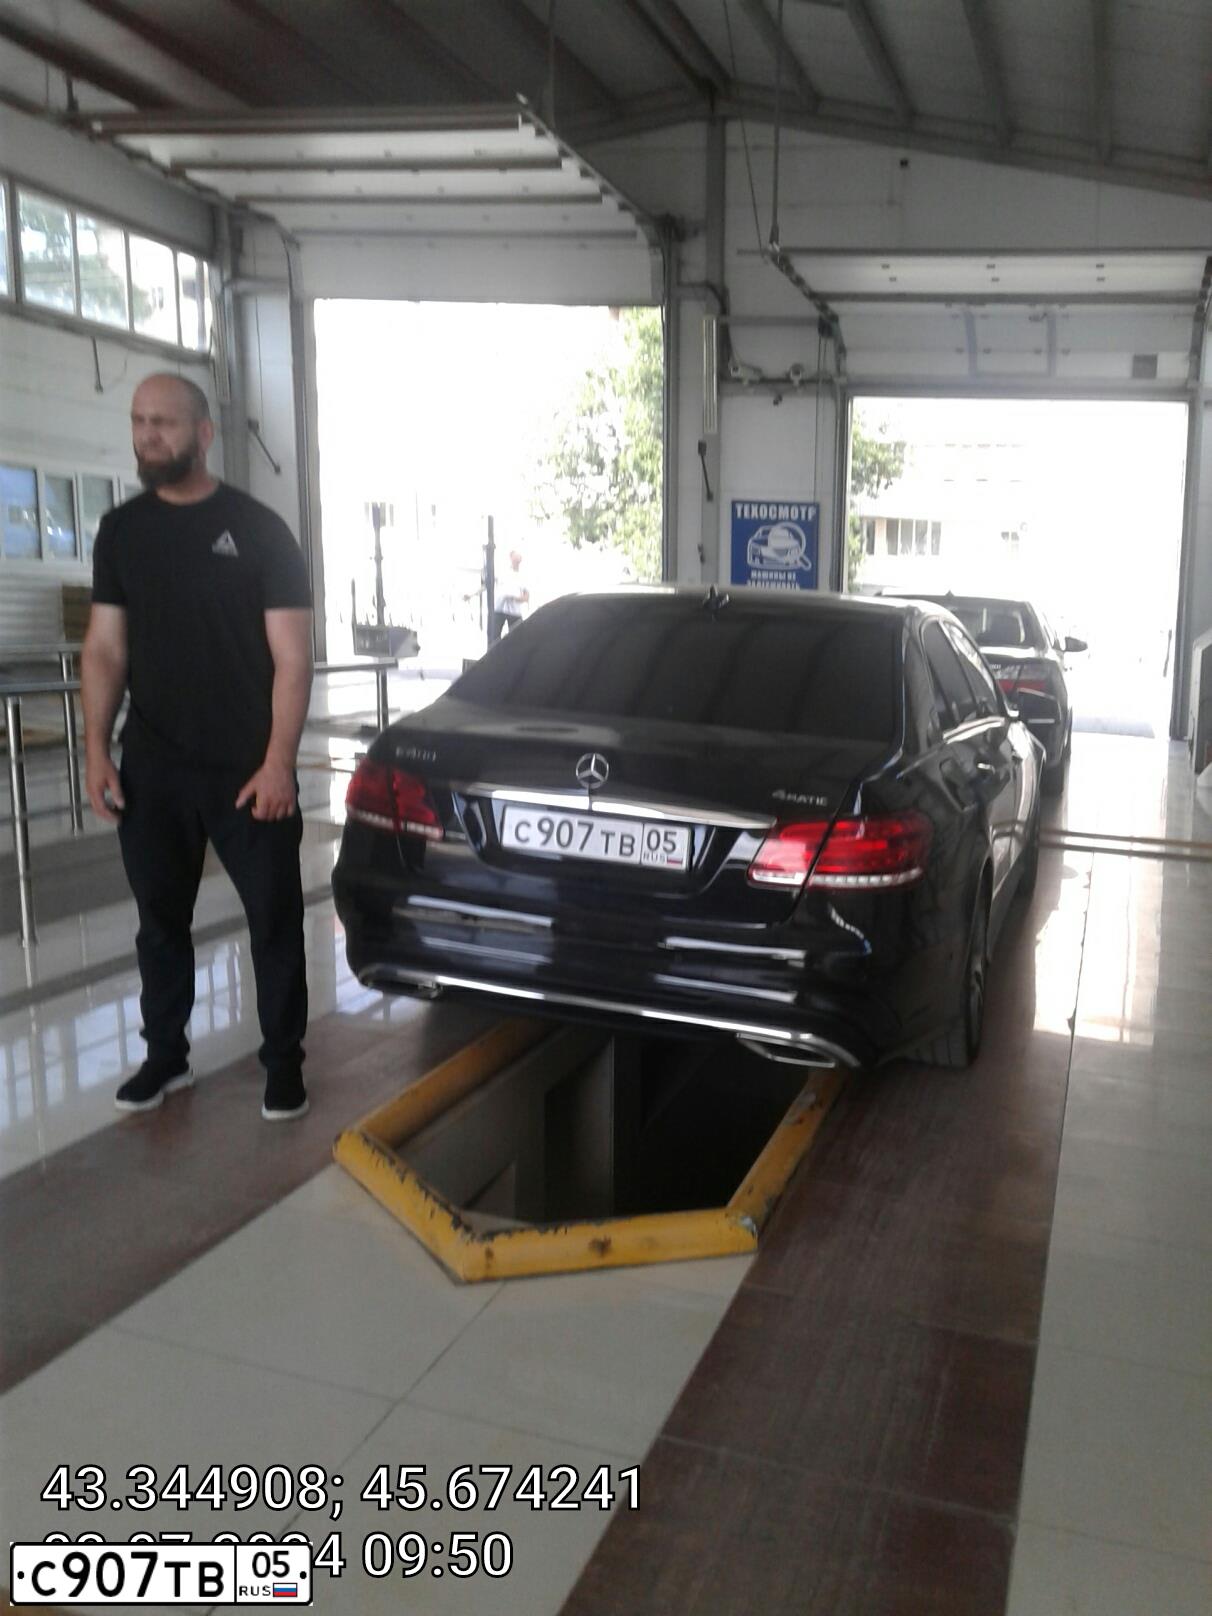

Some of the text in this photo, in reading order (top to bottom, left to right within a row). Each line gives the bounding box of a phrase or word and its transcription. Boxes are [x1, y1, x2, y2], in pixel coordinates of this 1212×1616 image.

[736, 503, 817, 521] ТЕХОСМОТР
[646, 828, 677, 854] 05
[643, 852, 666, 864] RUS
